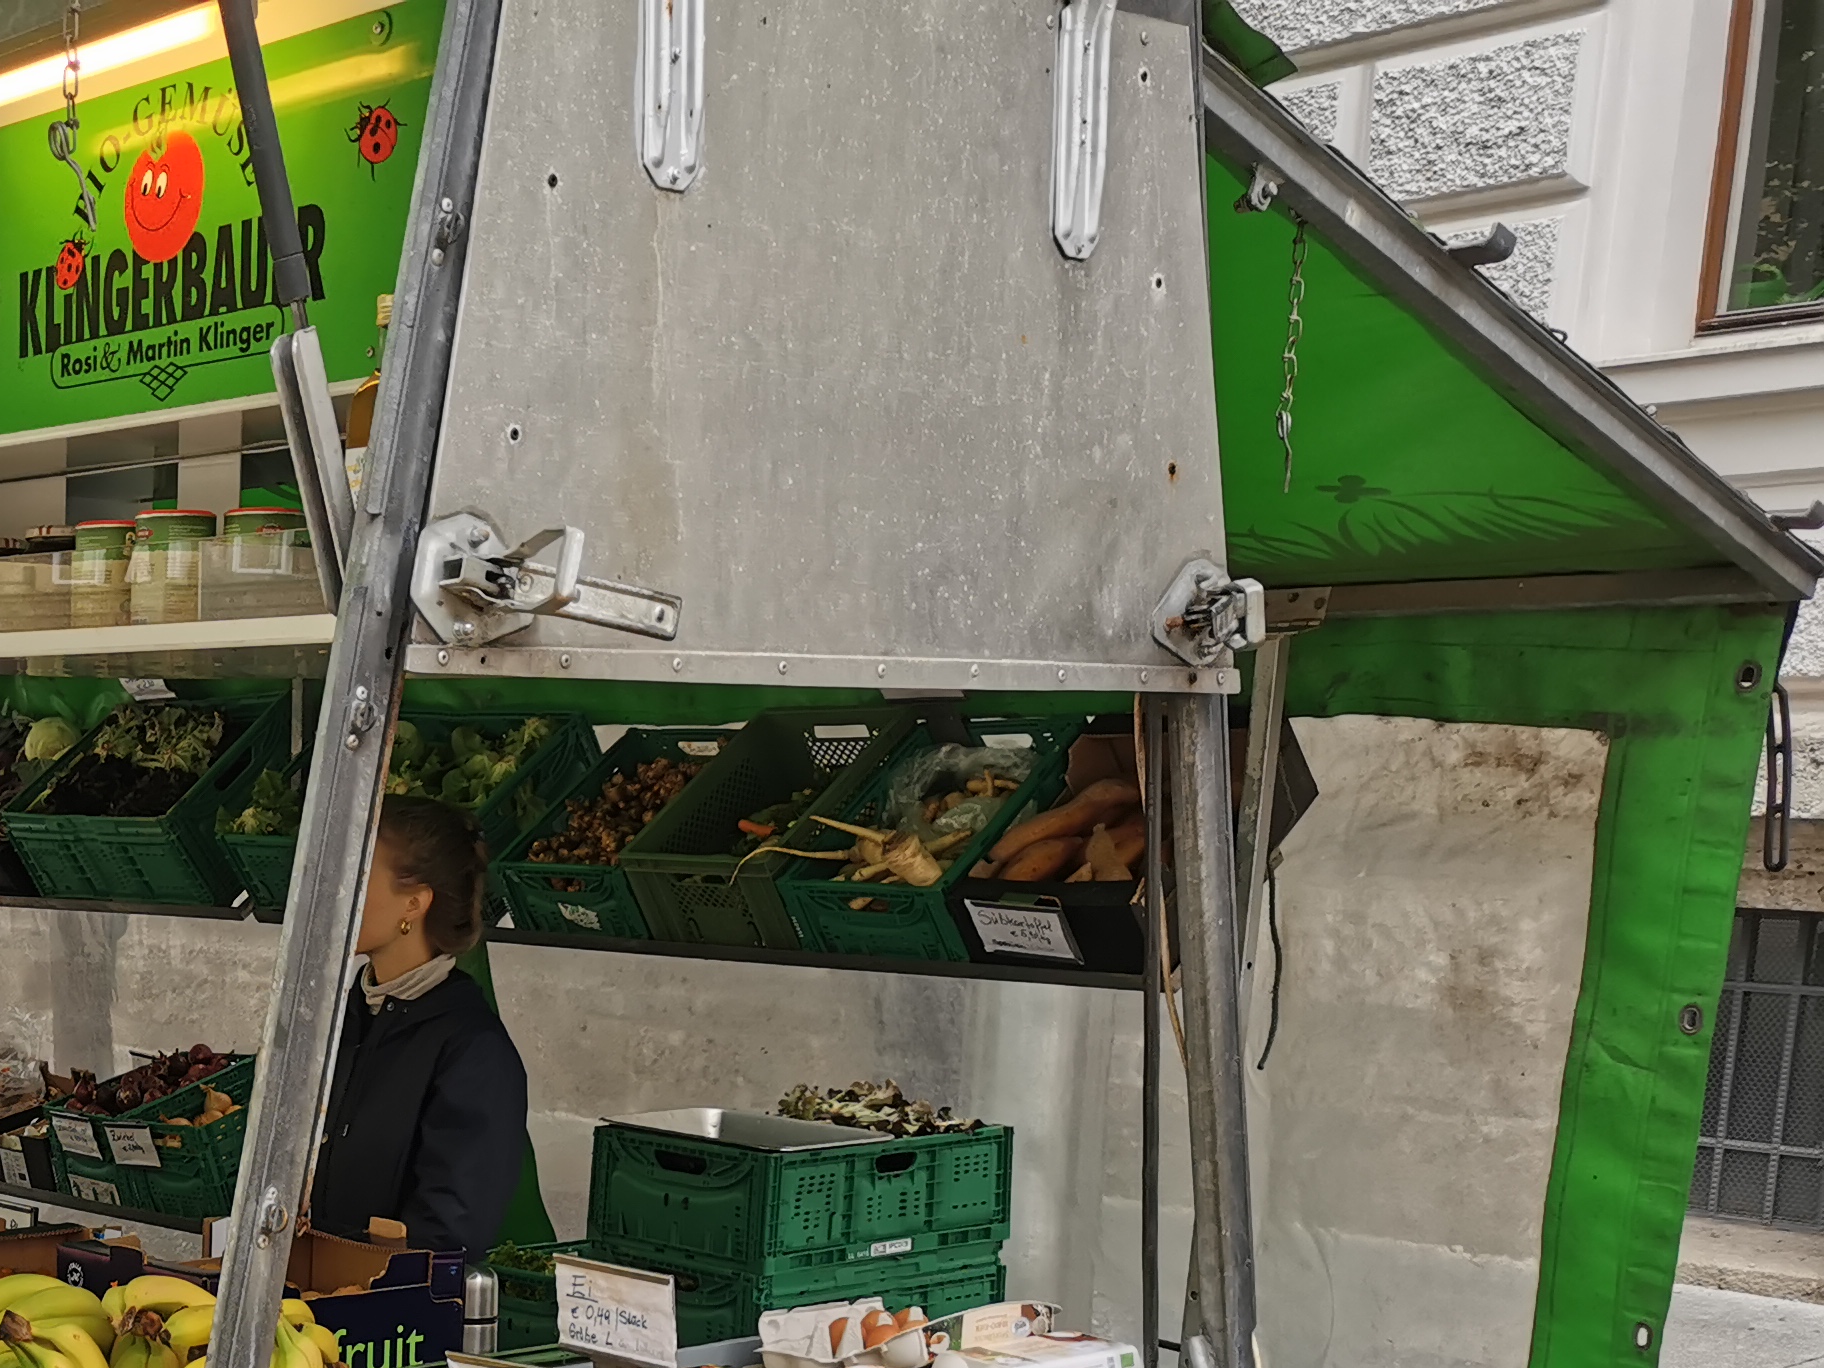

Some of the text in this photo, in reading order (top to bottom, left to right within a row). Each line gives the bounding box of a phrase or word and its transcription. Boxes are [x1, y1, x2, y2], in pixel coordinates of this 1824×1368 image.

[59, 319, 276, 378] Rosi & Martin Klinger
[571, 1274, 593, 1299] Ei
[571, 1306, 579, 1319] €
[605, 1330, 614, 1346] L
